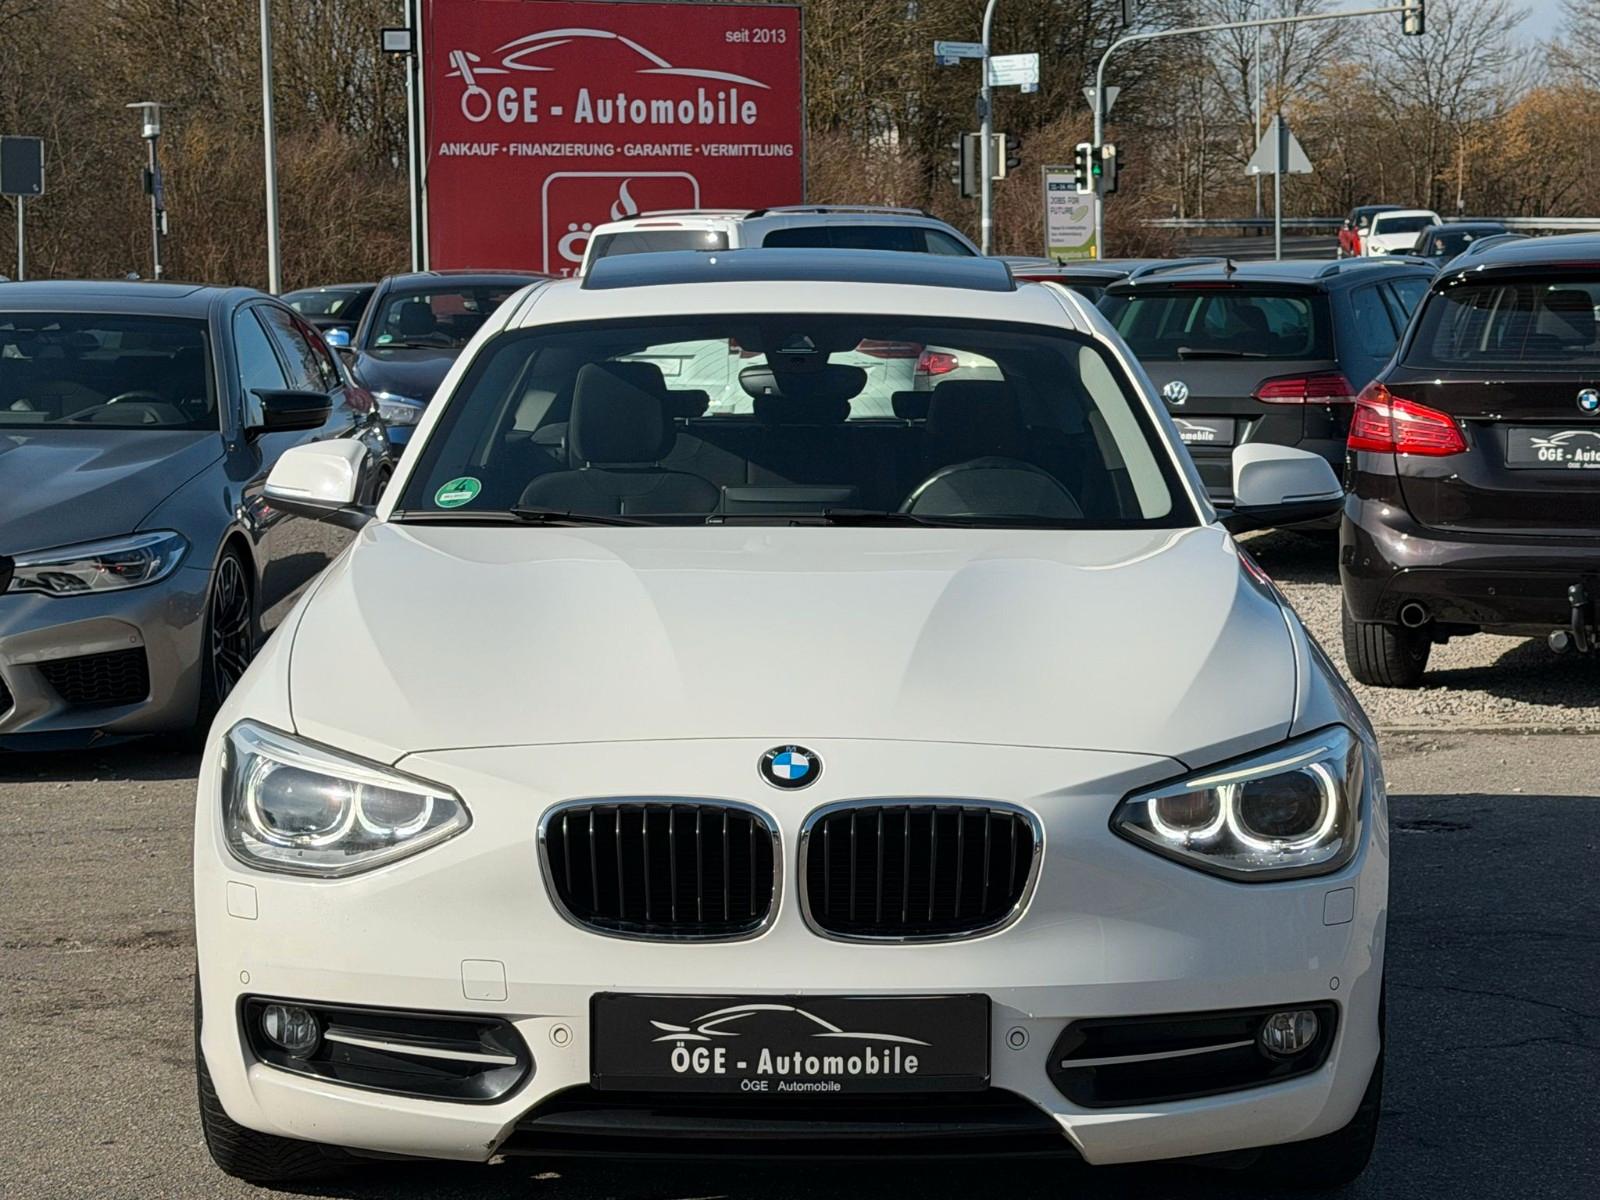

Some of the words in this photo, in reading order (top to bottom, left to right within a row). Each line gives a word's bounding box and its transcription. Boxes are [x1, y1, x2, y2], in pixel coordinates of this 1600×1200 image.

[725, 29, 749, 42] seit
[753, 29, 786, 43] 2013
[574, 87, 757, 124] Automobile
[439, 143, 499, 156] ANKAUF
[509, 143, 614, 156] FINANZIERUNG
[624, 144, 693, 157] GARANTIE
[701, 144, 793, 157] VERMITTLUNG
[1180, 431, 1215, 441] omobile
[1538, 447, 1564, 461] ÖGE
[1574, 448, 1600, 461] Auto
[454, 479, 468, 493] 4
[671, 1041, 726, 1074] ÖGE
[757, 1046, 919, 1075] Automobile
[740, 1079, 769, 1092] ÖGE
[777, 1080, 841, 1092] Automobile
